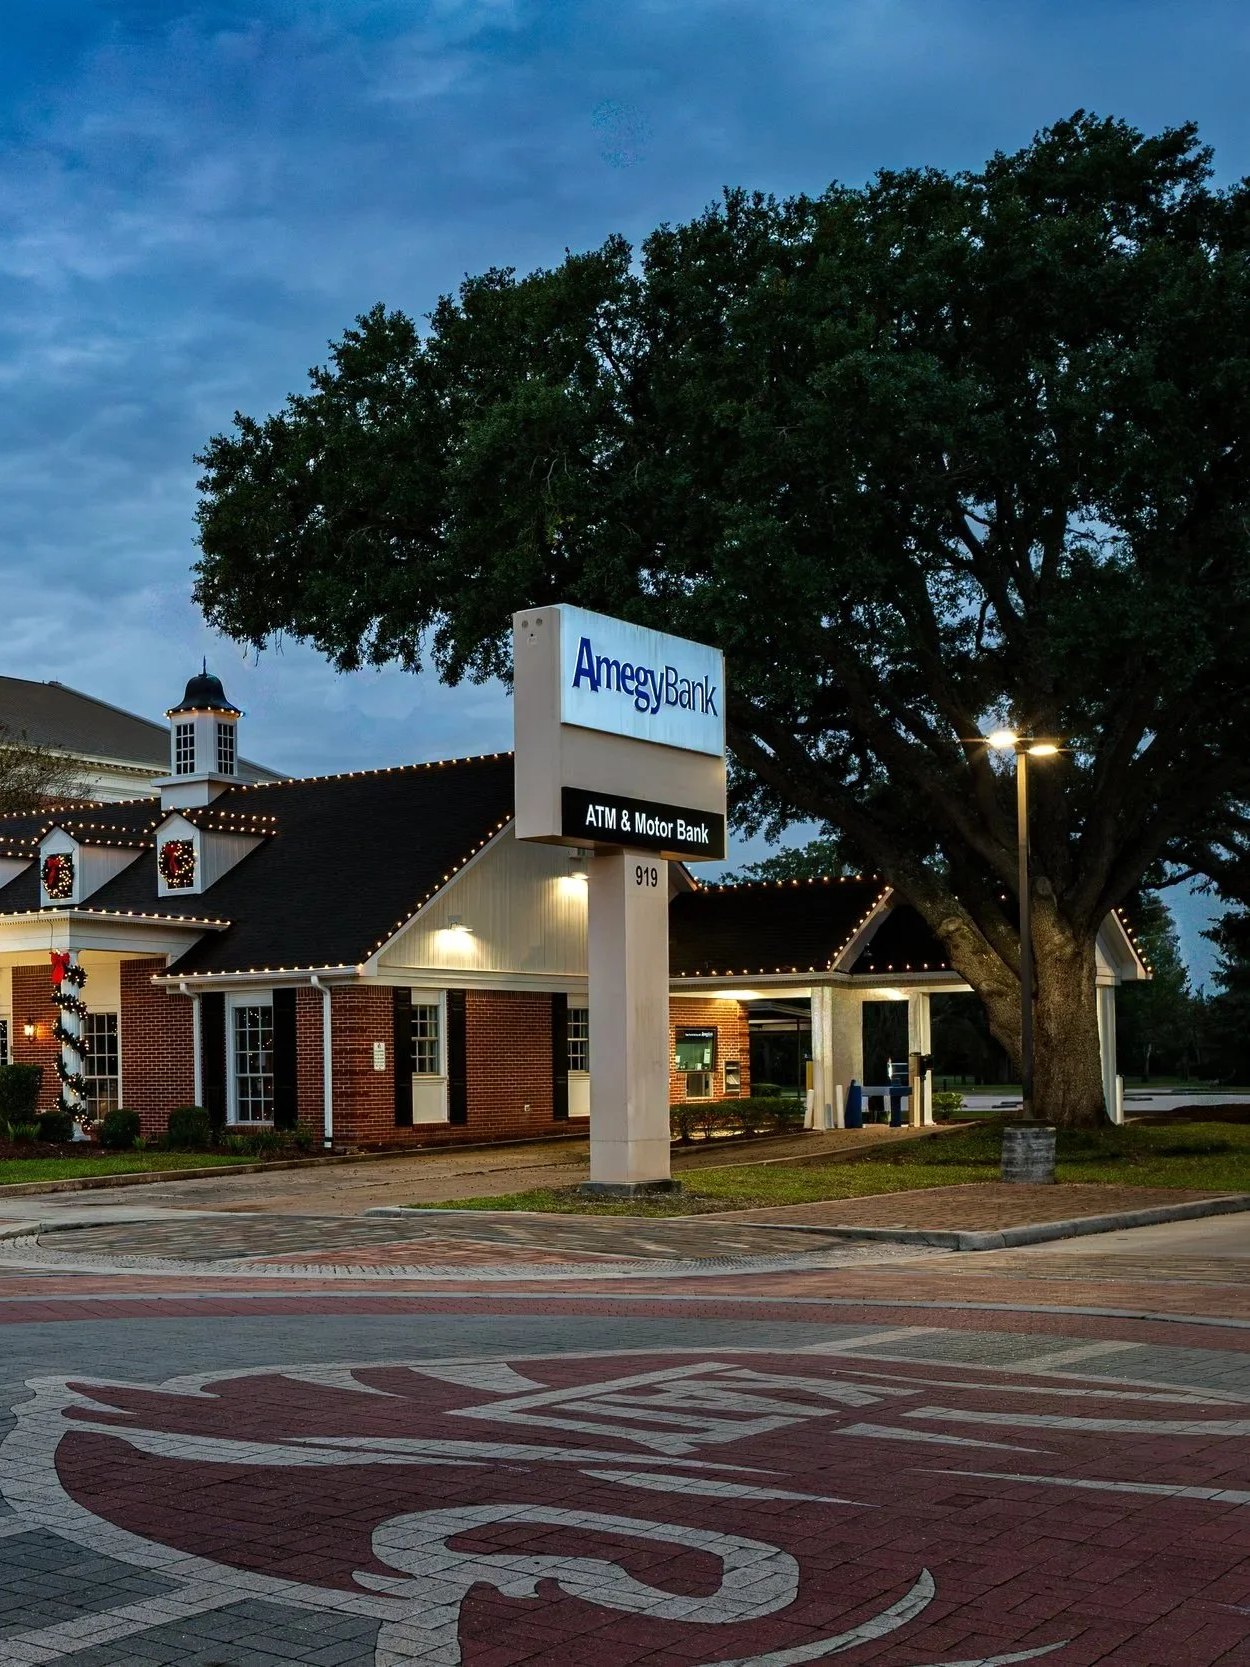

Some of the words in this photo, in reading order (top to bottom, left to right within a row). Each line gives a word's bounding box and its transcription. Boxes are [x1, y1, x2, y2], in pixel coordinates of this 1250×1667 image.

[572, 636, 718, 717] AmegyBank
[585, 804, 616, 830] ATM
[620, 814, 631, 832] &
[634, 812, 673, 839] Motor
[677, 819, 709, 845] Bank
[635, 865, 658, 888] 919
